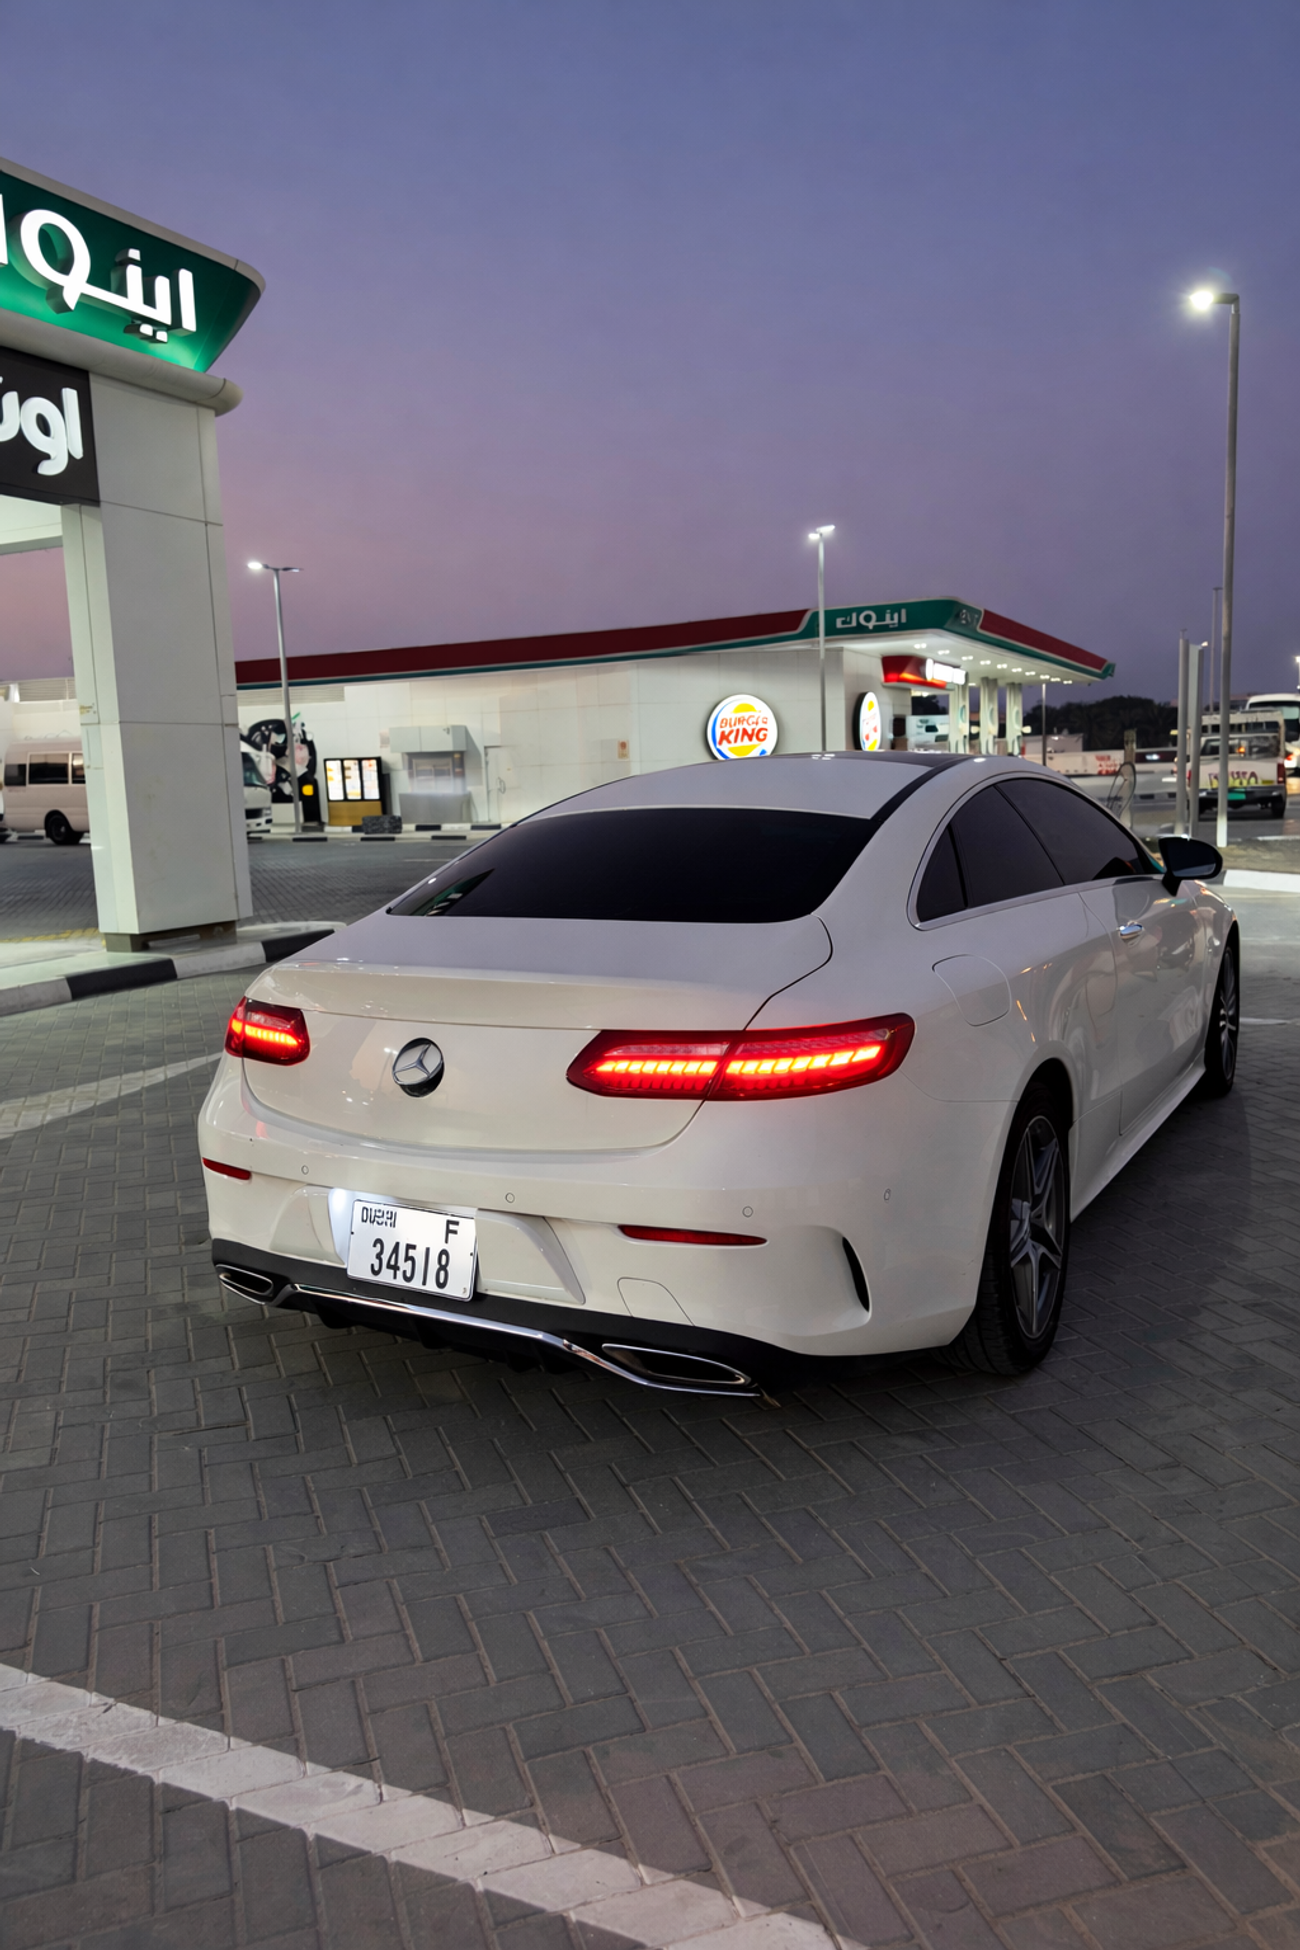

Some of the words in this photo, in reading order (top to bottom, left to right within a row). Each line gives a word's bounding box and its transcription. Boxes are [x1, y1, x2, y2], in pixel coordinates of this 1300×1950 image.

[0, 193, 197, 343] اينو
[836, 608, 907, 630] اينوك
[718, 727, 769, 746] KING
[444, 1219, 460, 1244] F
[370, 1237, 450, 1290] 34518
